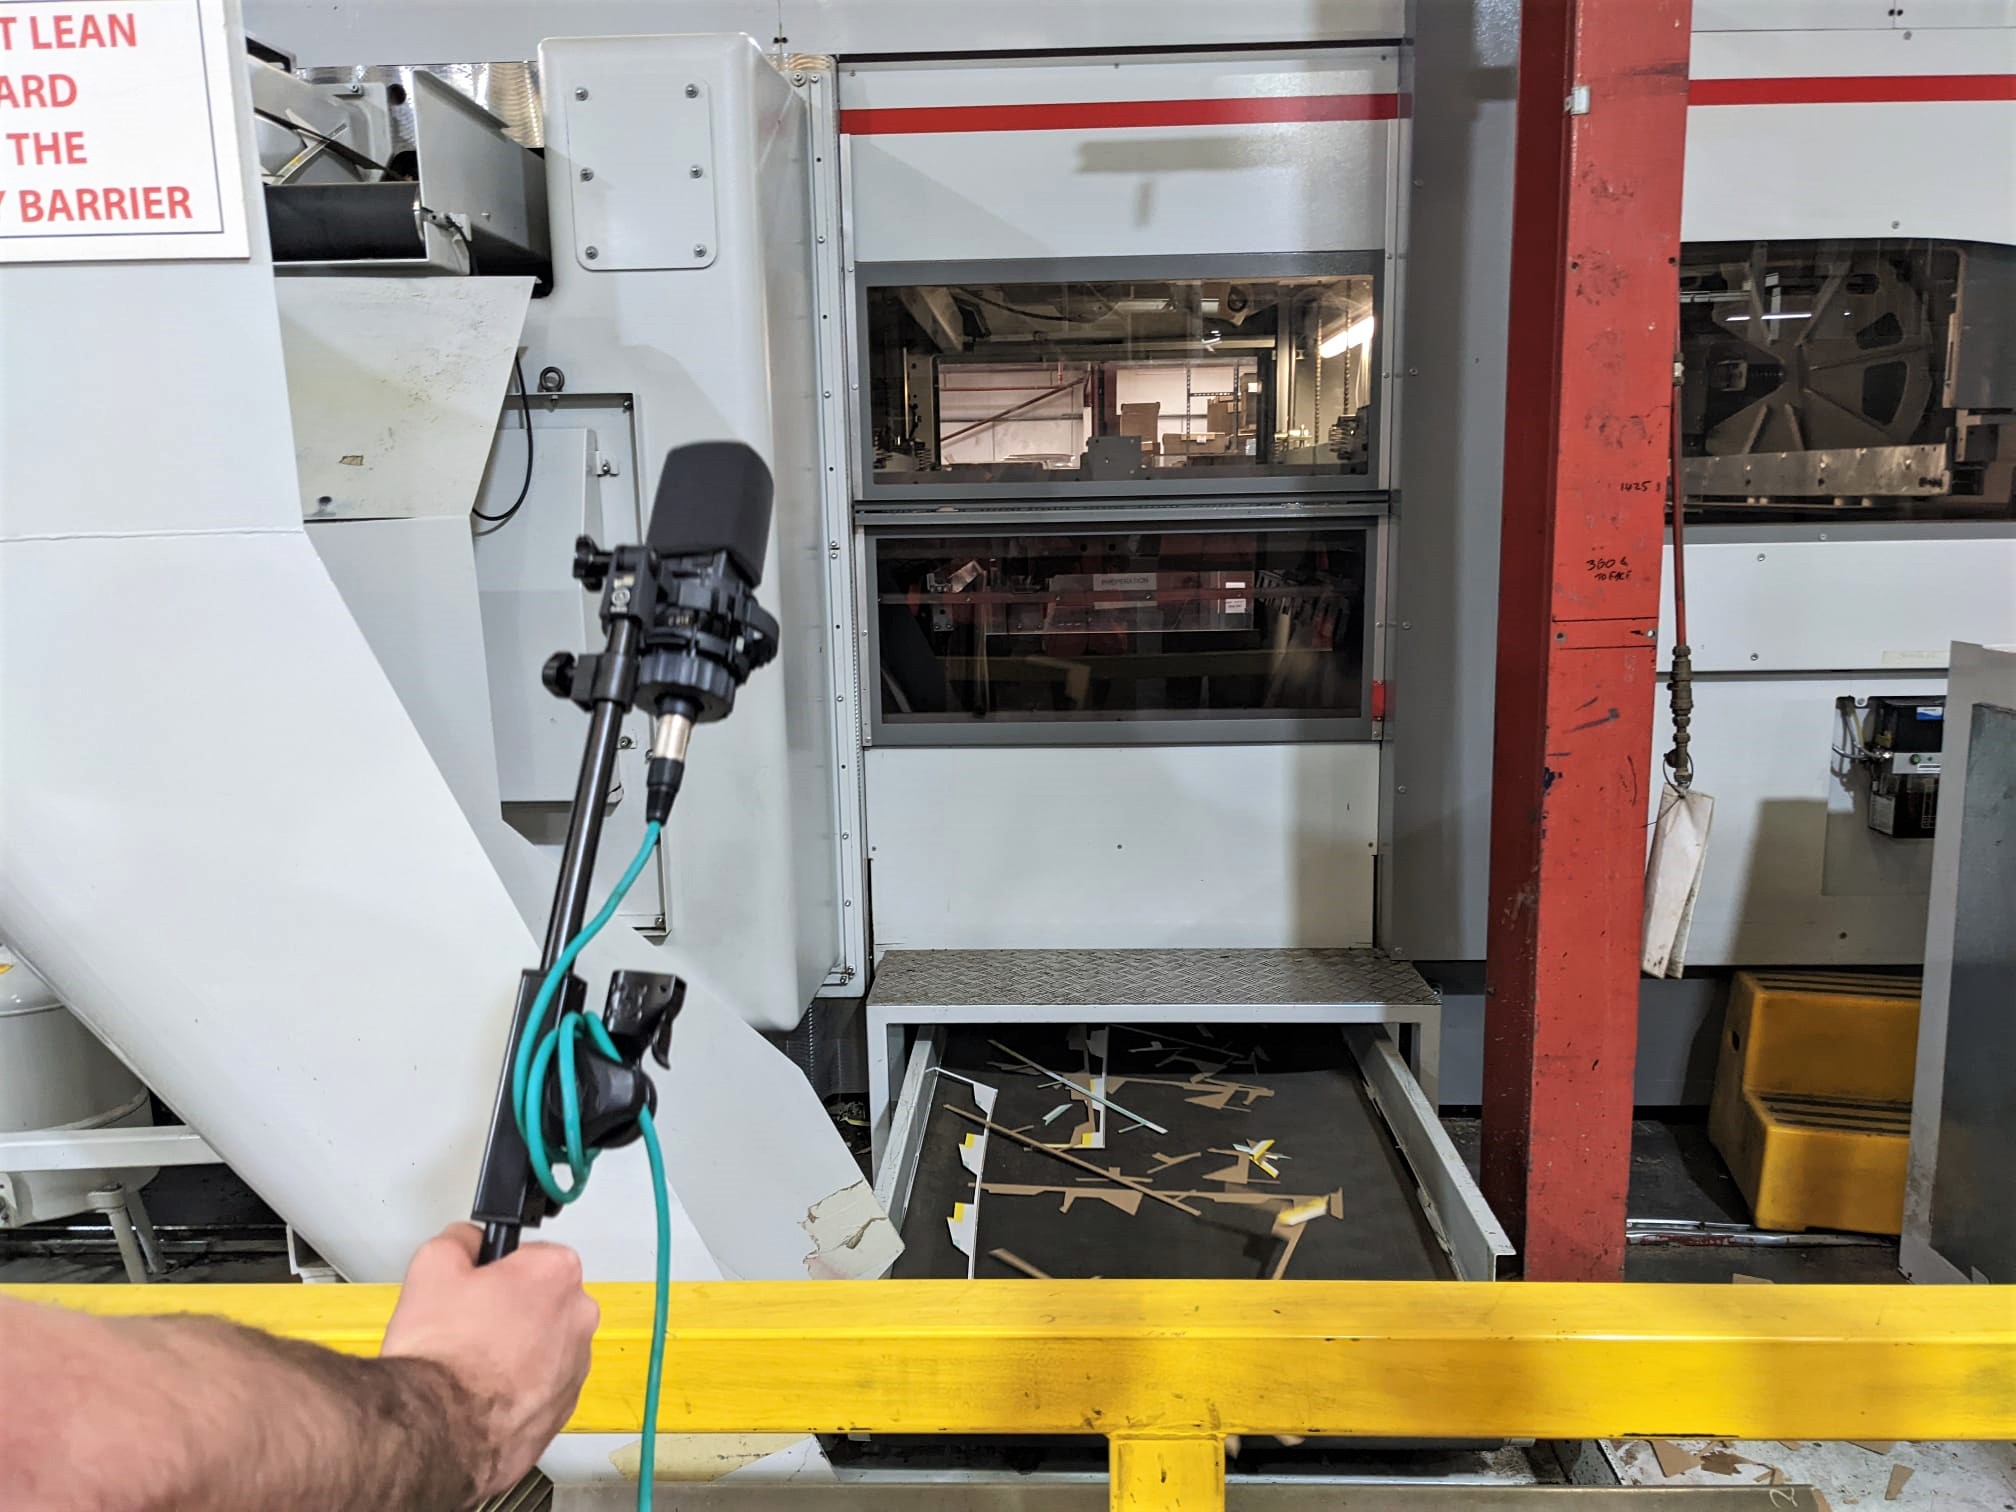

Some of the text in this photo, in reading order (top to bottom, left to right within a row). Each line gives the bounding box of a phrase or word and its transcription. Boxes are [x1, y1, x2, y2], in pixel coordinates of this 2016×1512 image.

[30, 13, 137, 49] LEAN
[6, 131, 87, 165] THE
[19, 186, 193, 222] BARRIER
